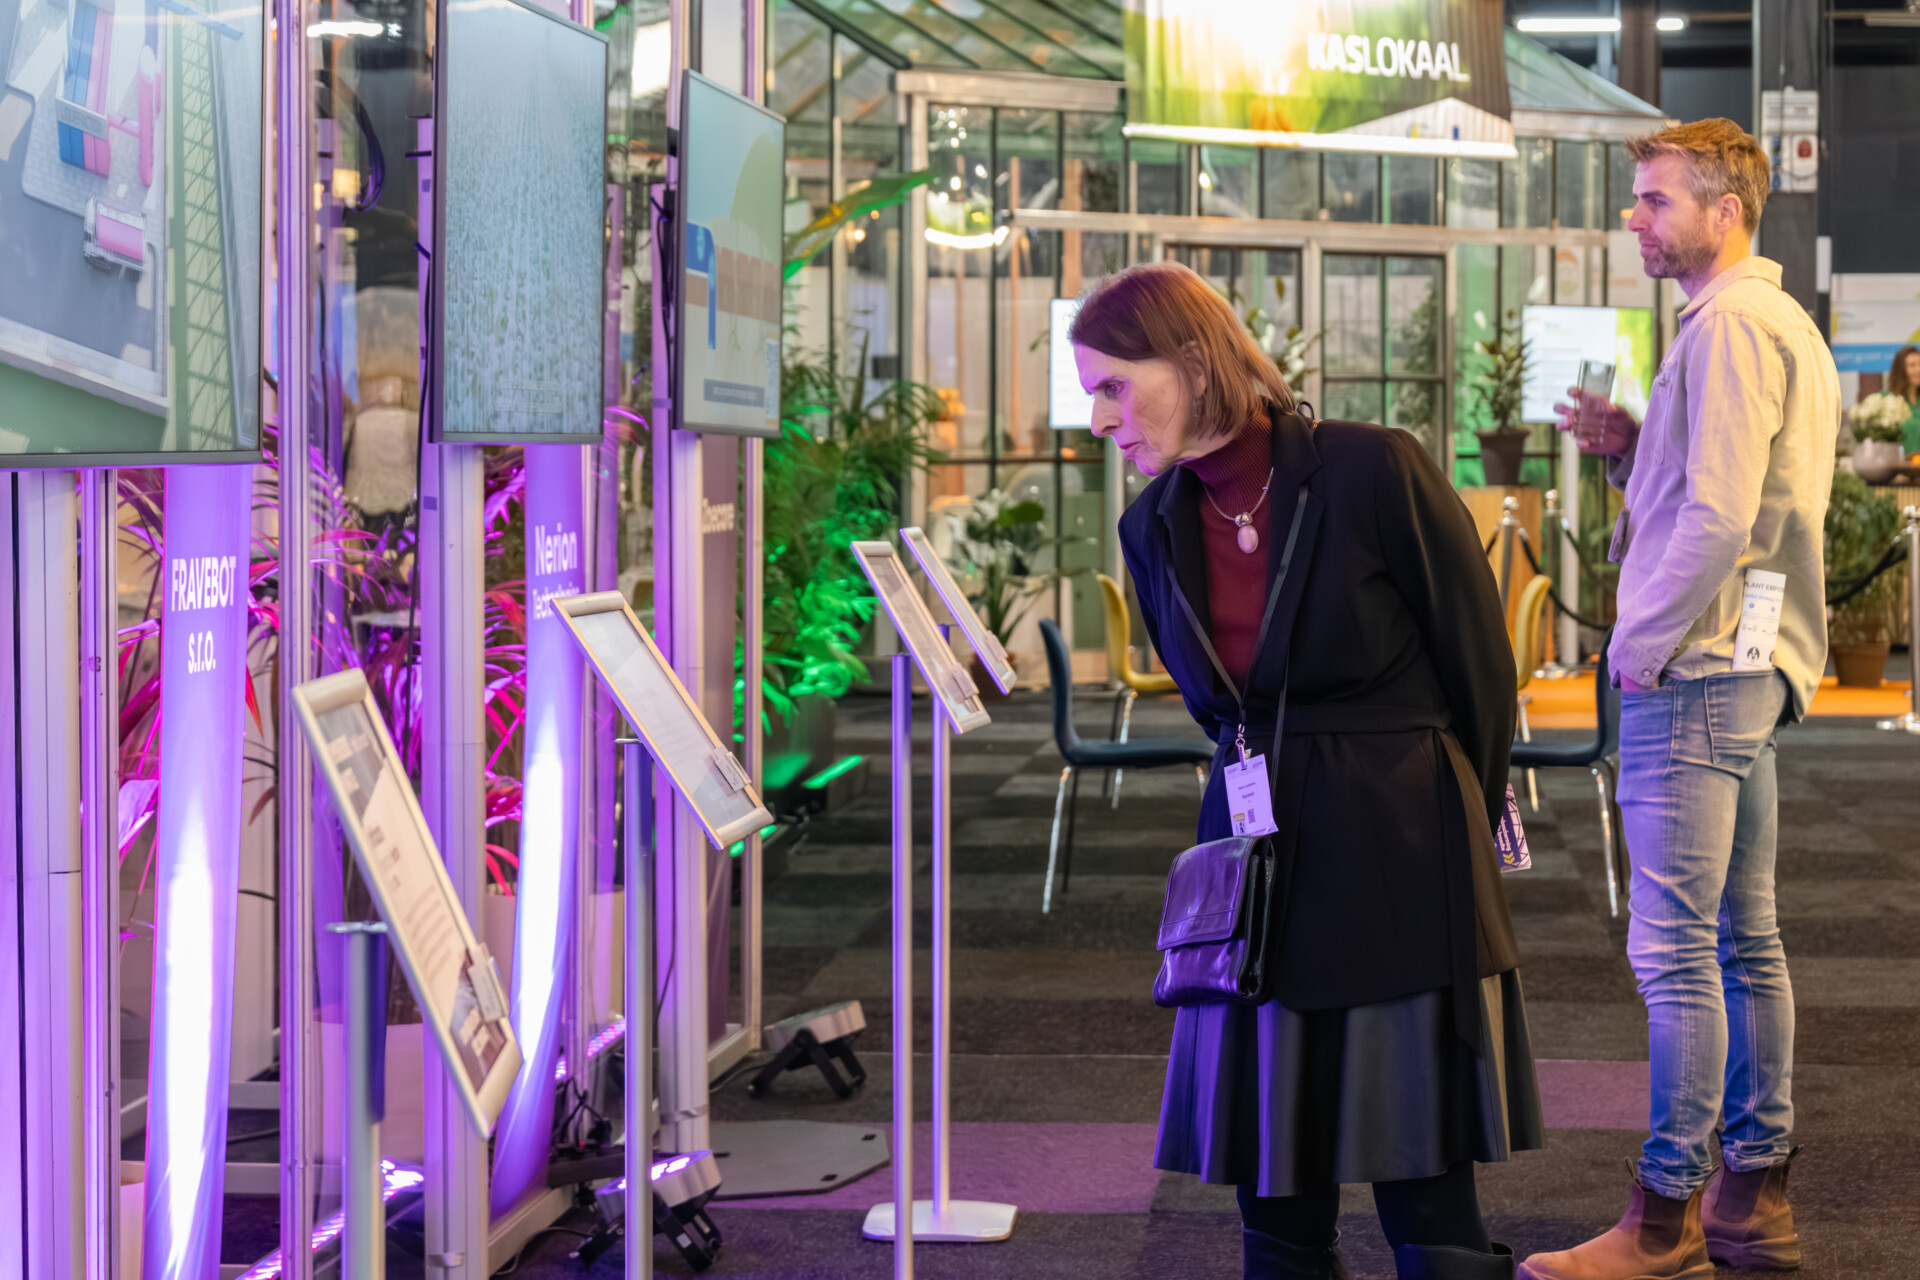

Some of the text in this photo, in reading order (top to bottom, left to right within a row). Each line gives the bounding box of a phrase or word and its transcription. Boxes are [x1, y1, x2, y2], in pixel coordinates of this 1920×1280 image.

[1307, 32, 1471, 82] KASLOKAAL
[534, 522, 578, 576] Nerion
[171, 555, 237, 612] FRAVEBOT
[188, 630, 216, 674] s.r.o.
